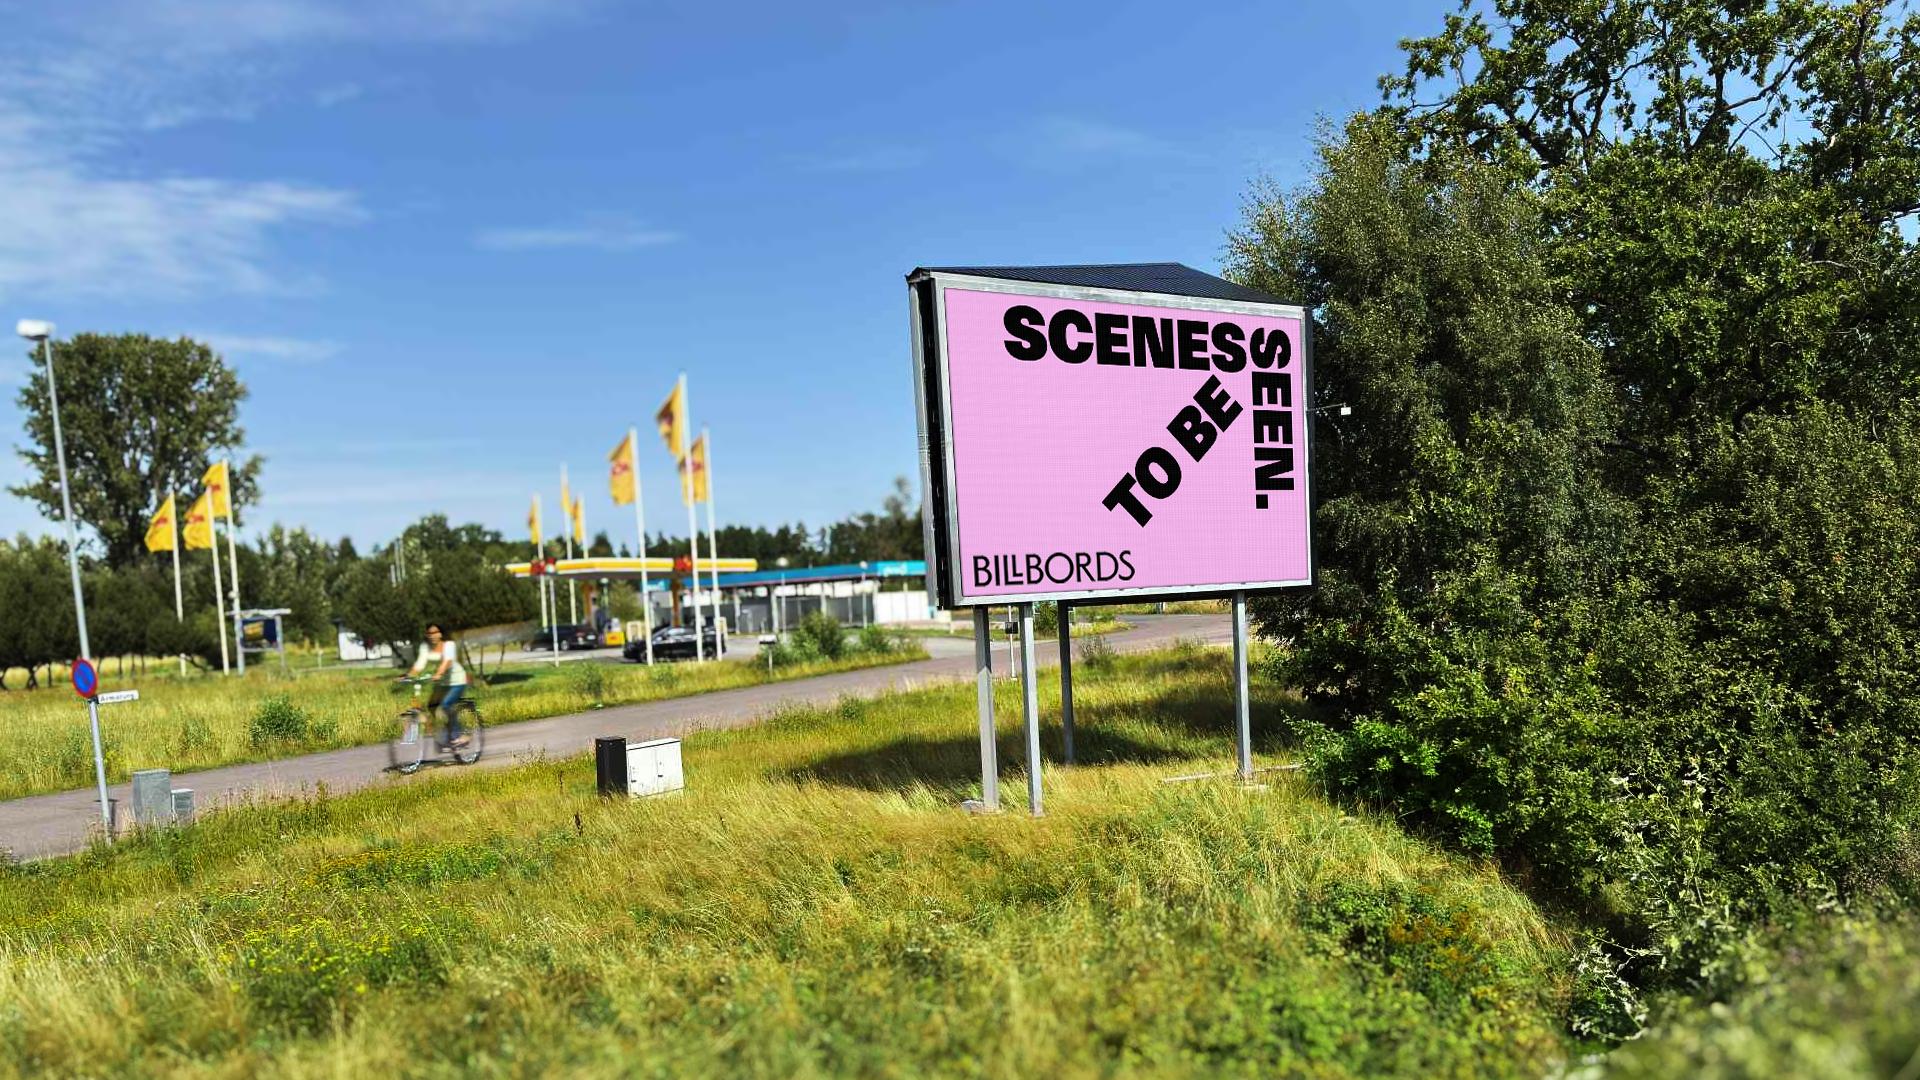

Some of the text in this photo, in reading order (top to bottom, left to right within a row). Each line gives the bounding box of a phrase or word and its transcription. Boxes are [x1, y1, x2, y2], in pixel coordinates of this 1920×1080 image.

[1003, 305, 1247, 374] SCENES
[1101, 374, 1244, 528] TO BE
[1250, 327, 1295, 509] SEEN.
[972, 550, 1136, 588] BILLBORDS
